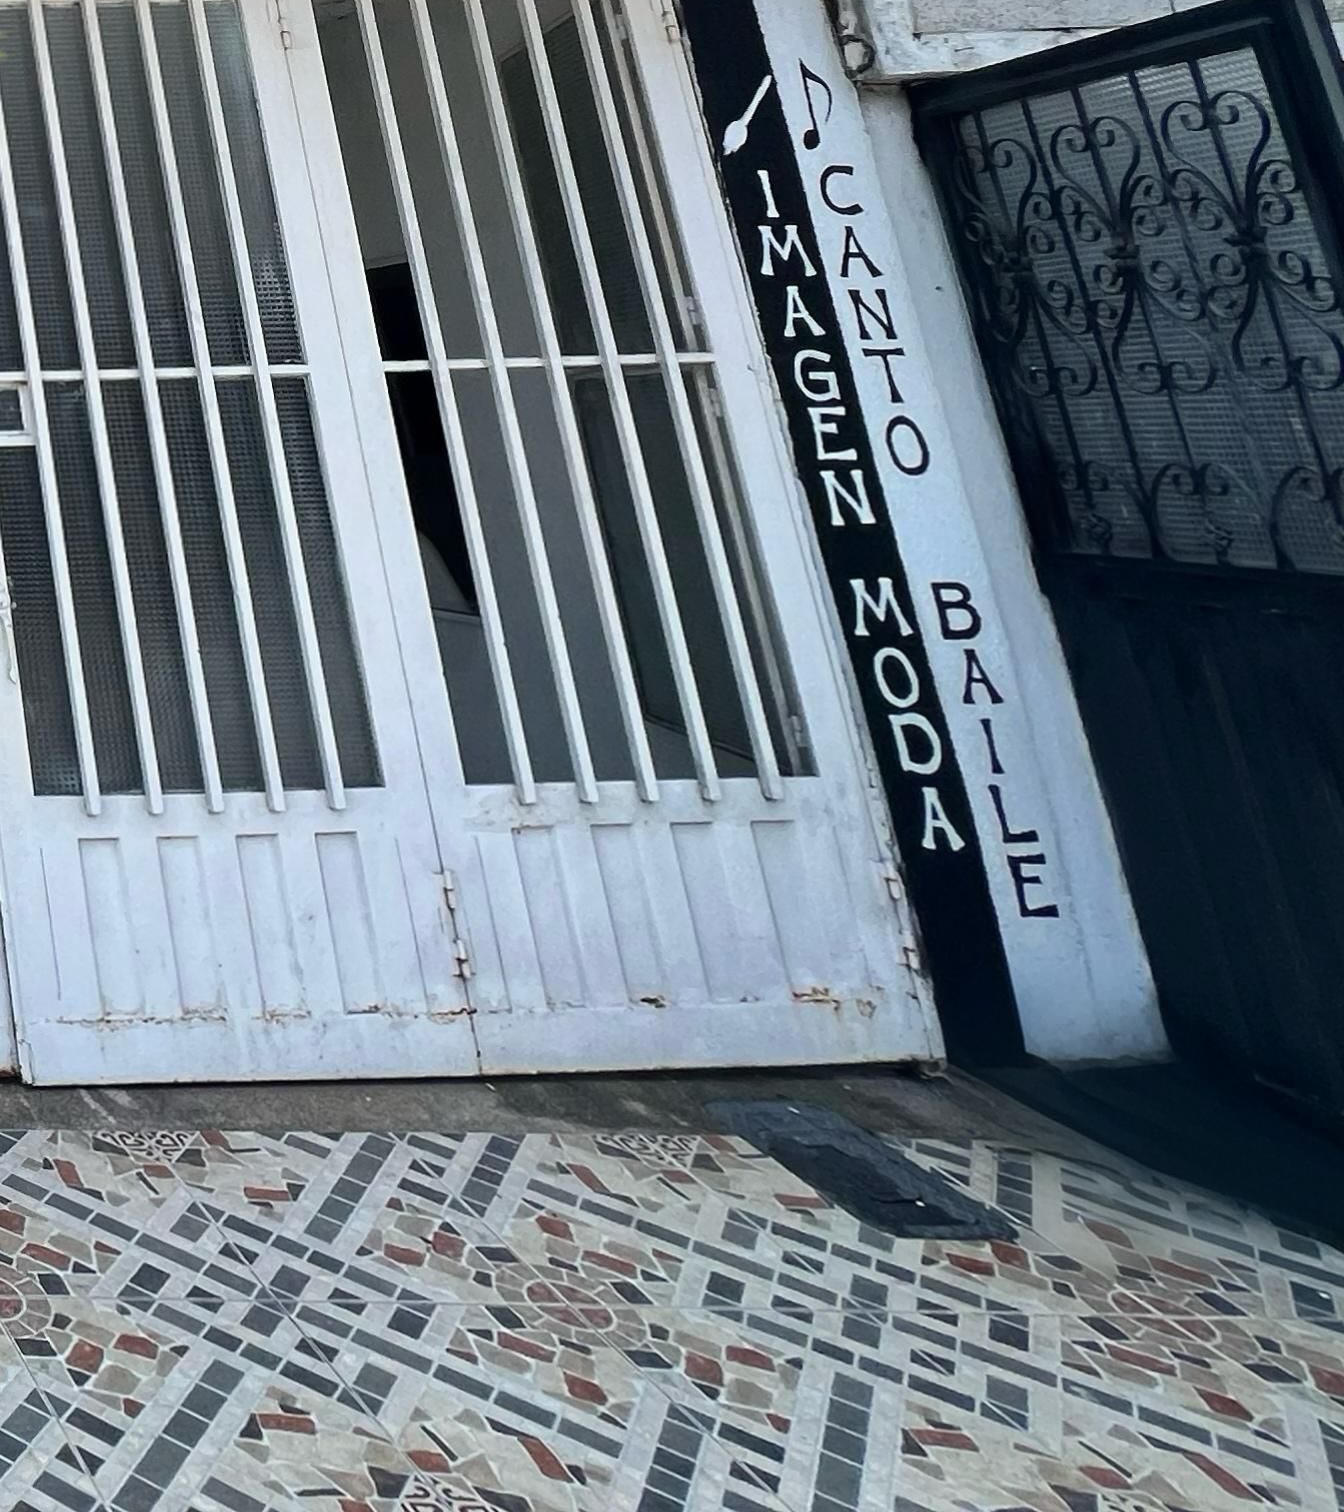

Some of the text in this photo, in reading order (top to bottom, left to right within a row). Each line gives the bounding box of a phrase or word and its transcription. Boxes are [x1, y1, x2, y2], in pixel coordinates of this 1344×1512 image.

[756, 170, 965, 852] IMAGEN MODA
[820, 164, 1060, 918] CANTO BAILE
